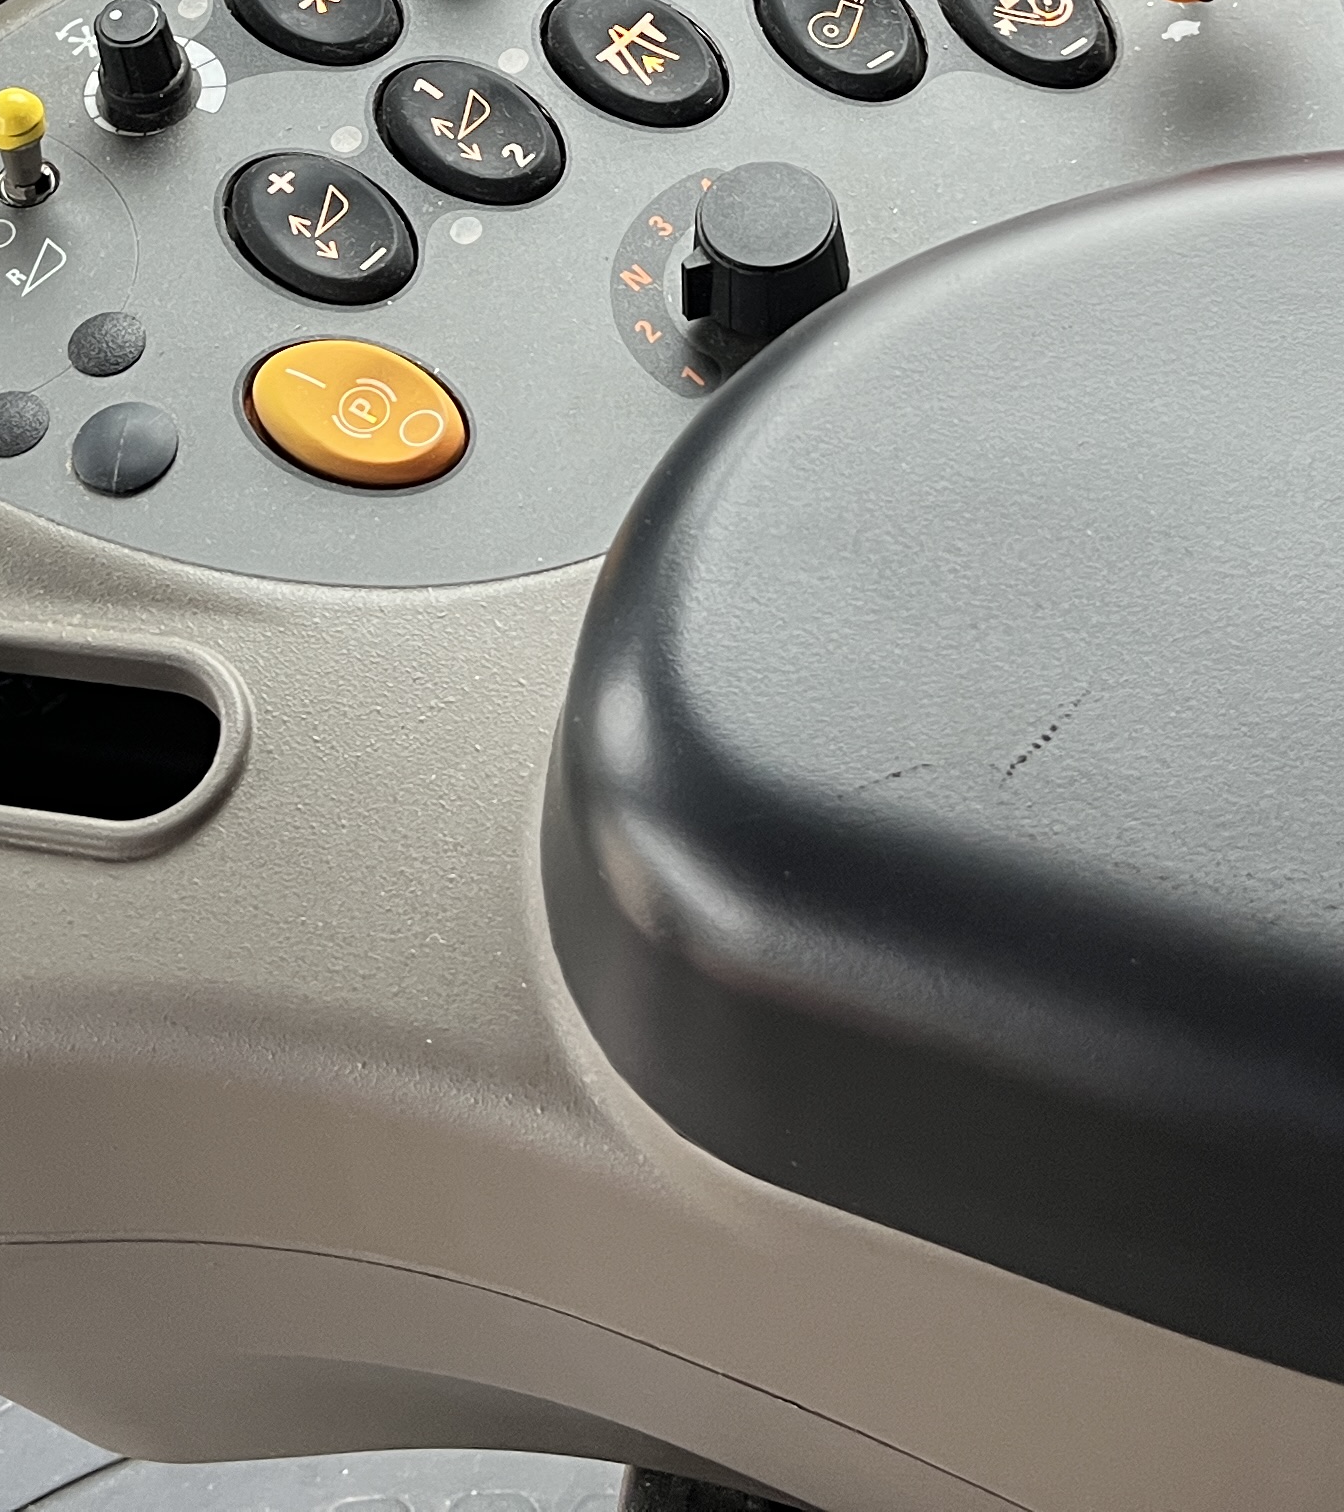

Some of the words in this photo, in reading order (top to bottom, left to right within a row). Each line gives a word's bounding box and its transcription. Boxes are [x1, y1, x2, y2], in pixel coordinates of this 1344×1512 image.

[413, 78, 444, 100] 1
[501, 143, 536, 168] 2
[648, 215, 674, 237] 3
[6, 268, 27, 286] R
[619, 263, 653, 292] N
[634, 320, 663, 344] 2
[680, 365, 705, 386] 1
[348, 397, 378, 424] P
